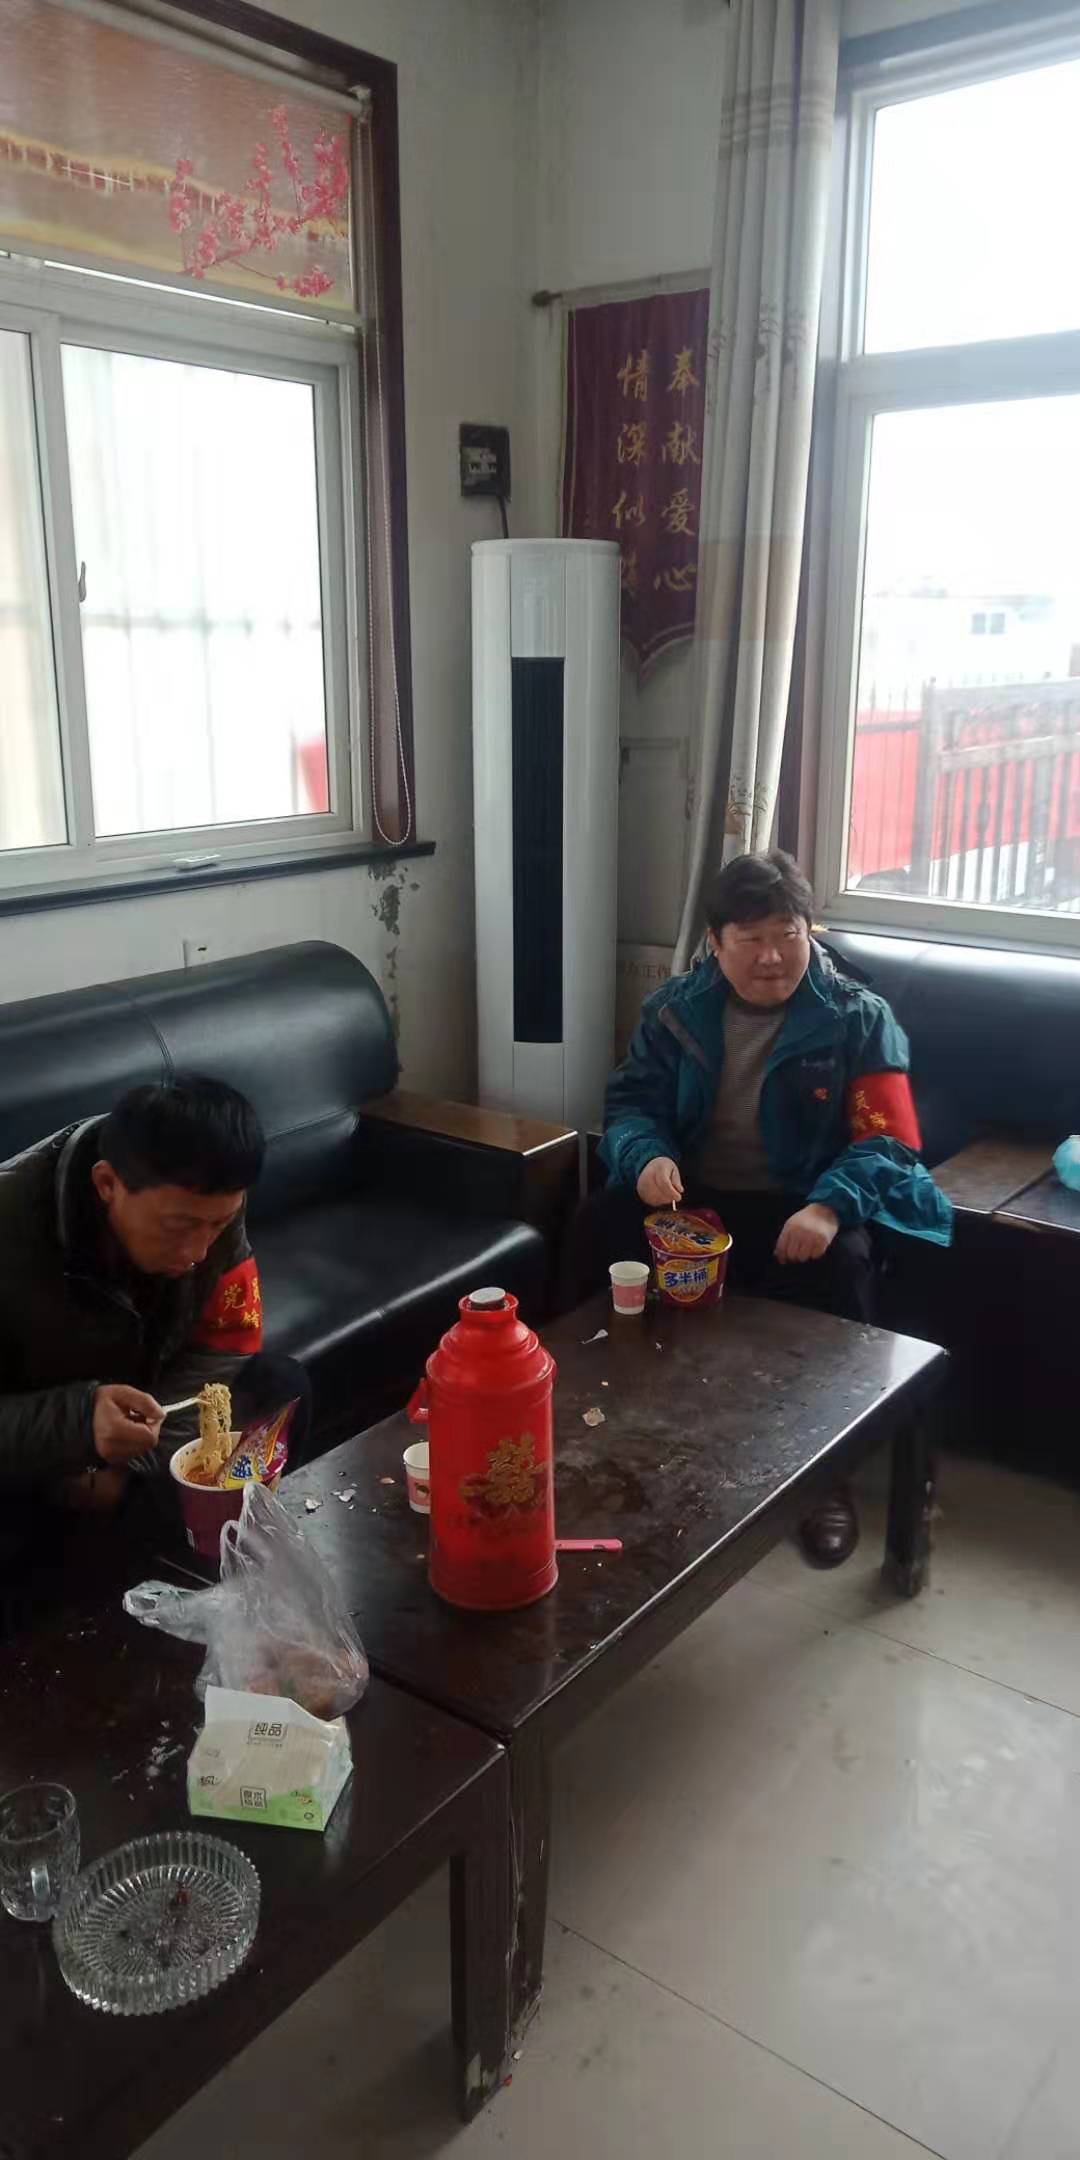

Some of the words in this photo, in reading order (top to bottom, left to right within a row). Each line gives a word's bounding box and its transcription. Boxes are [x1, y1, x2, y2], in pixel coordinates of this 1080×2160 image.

[655, 344, 701, 594] 奉献爱心
[223, 1278, 262, 1311] 党员
[664, 1268, 708, 1288] 多半桶
